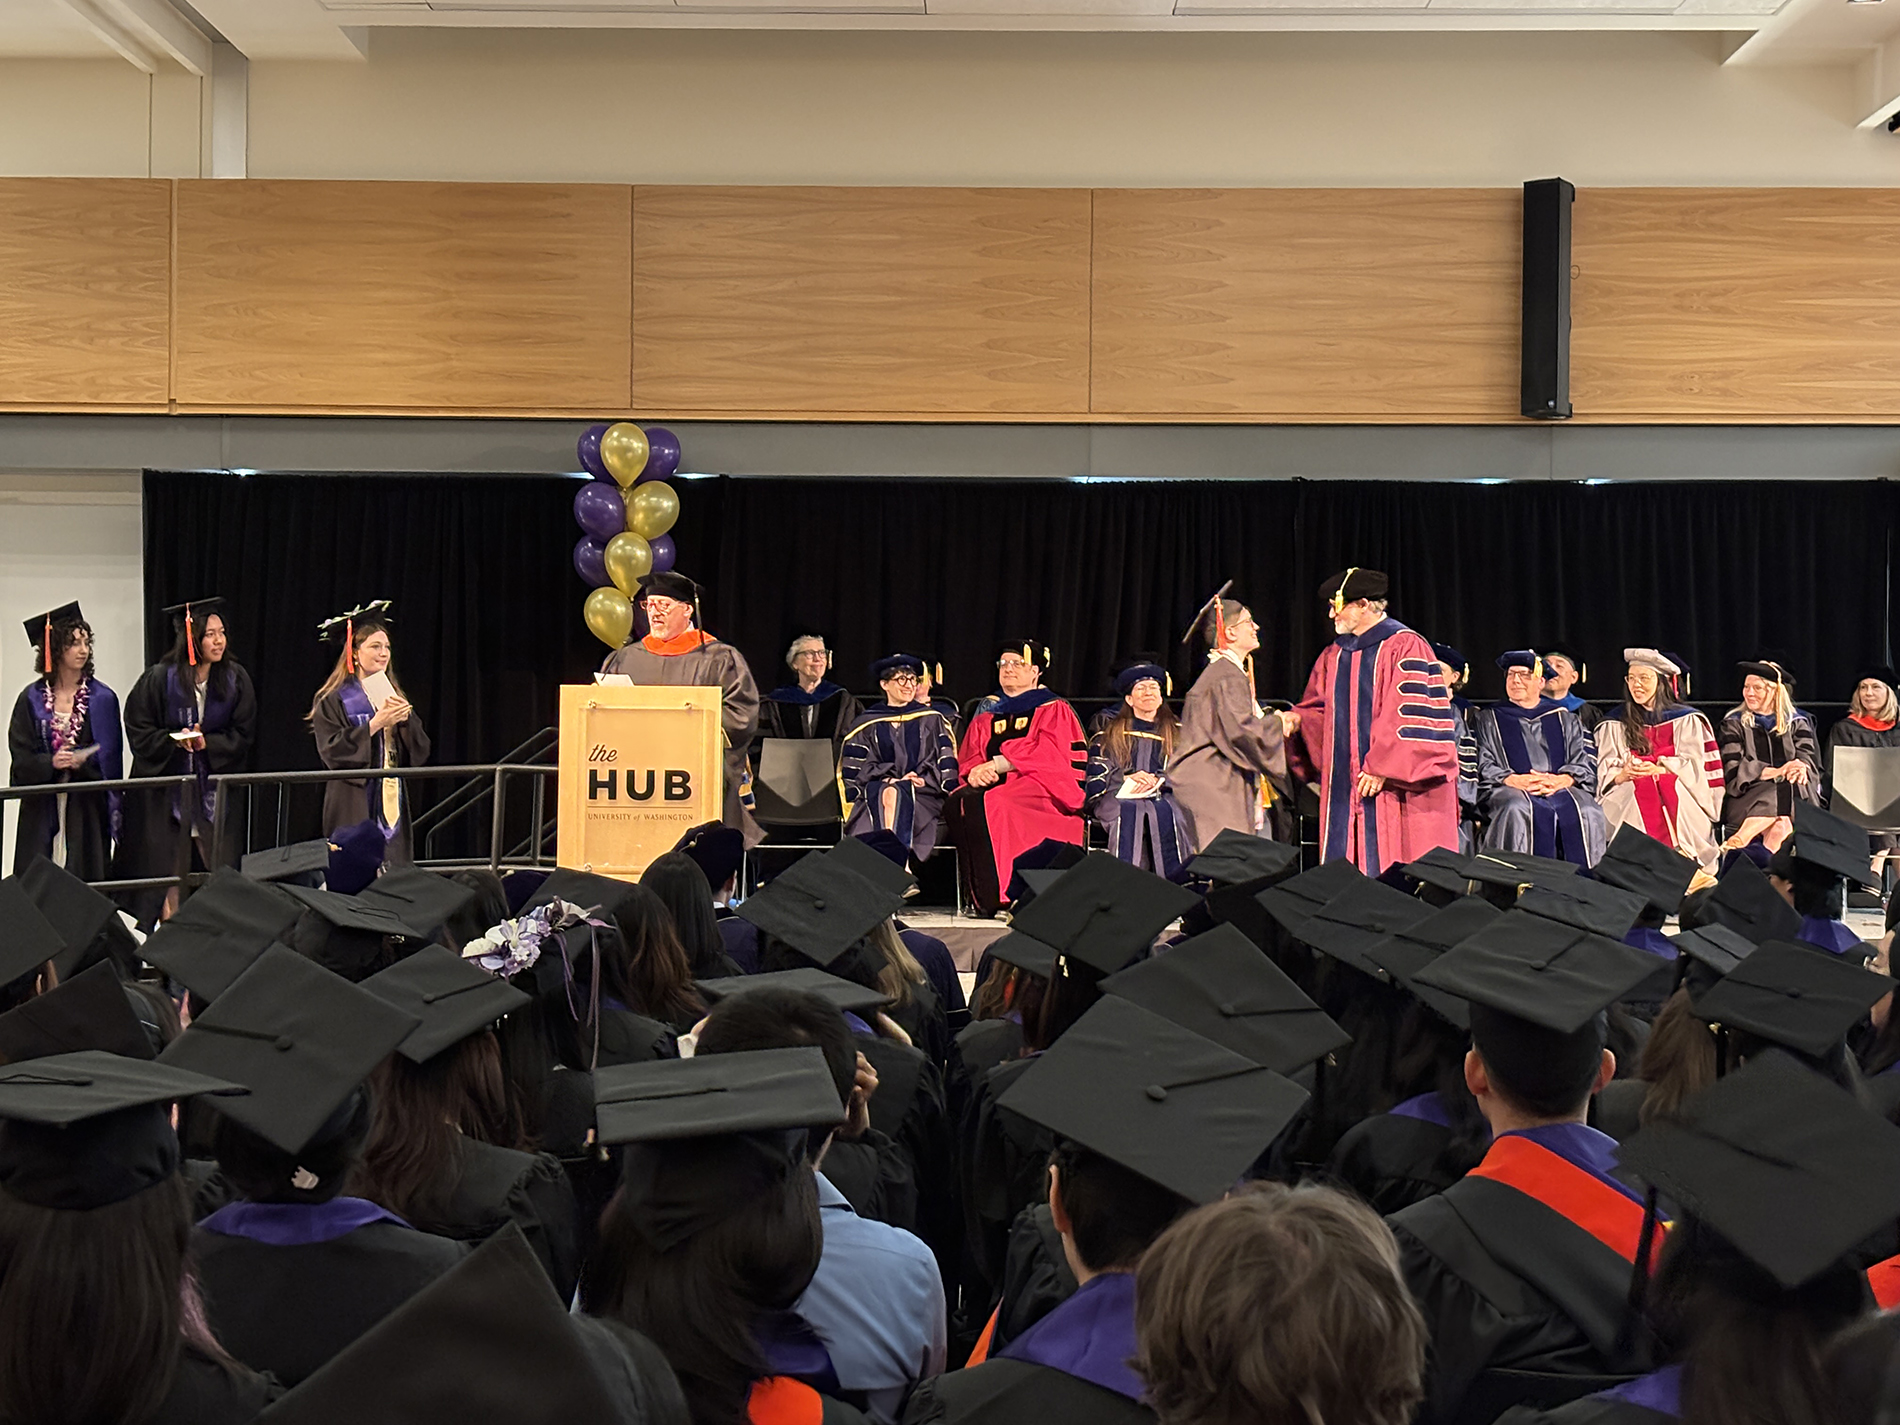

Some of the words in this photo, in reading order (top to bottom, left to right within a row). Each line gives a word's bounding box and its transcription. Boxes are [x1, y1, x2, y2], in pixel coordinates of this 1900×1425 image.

[588, 744, 618, 762] the
[588, 769, 692, 801] HUB
[587, 813, 632, 821] UNIVERSITY
[643, 813, 694, 821] WASHINGTON
